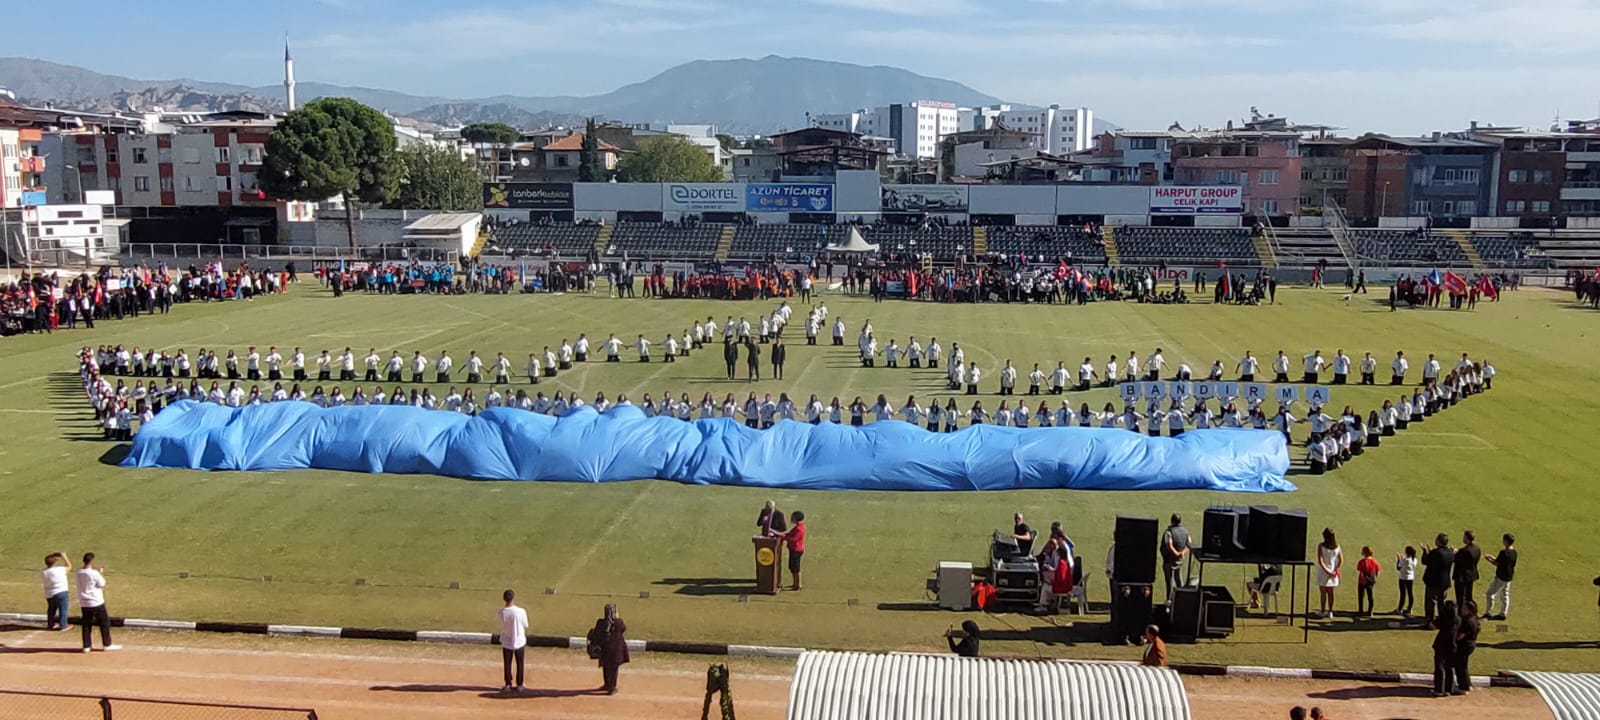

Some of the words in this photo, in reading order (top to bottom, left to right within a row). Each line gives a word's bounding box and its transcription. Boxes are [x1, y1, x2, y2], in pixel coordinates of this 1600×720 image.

[691, 189, 738, 199] DORTEL
[750, 187, 780, 195] AZUN
[784, 186, 829, 196] TİCARET
[1155, 188, 1197, 198] HARPUT
[1200, 188, 1238, 198] GROUP
